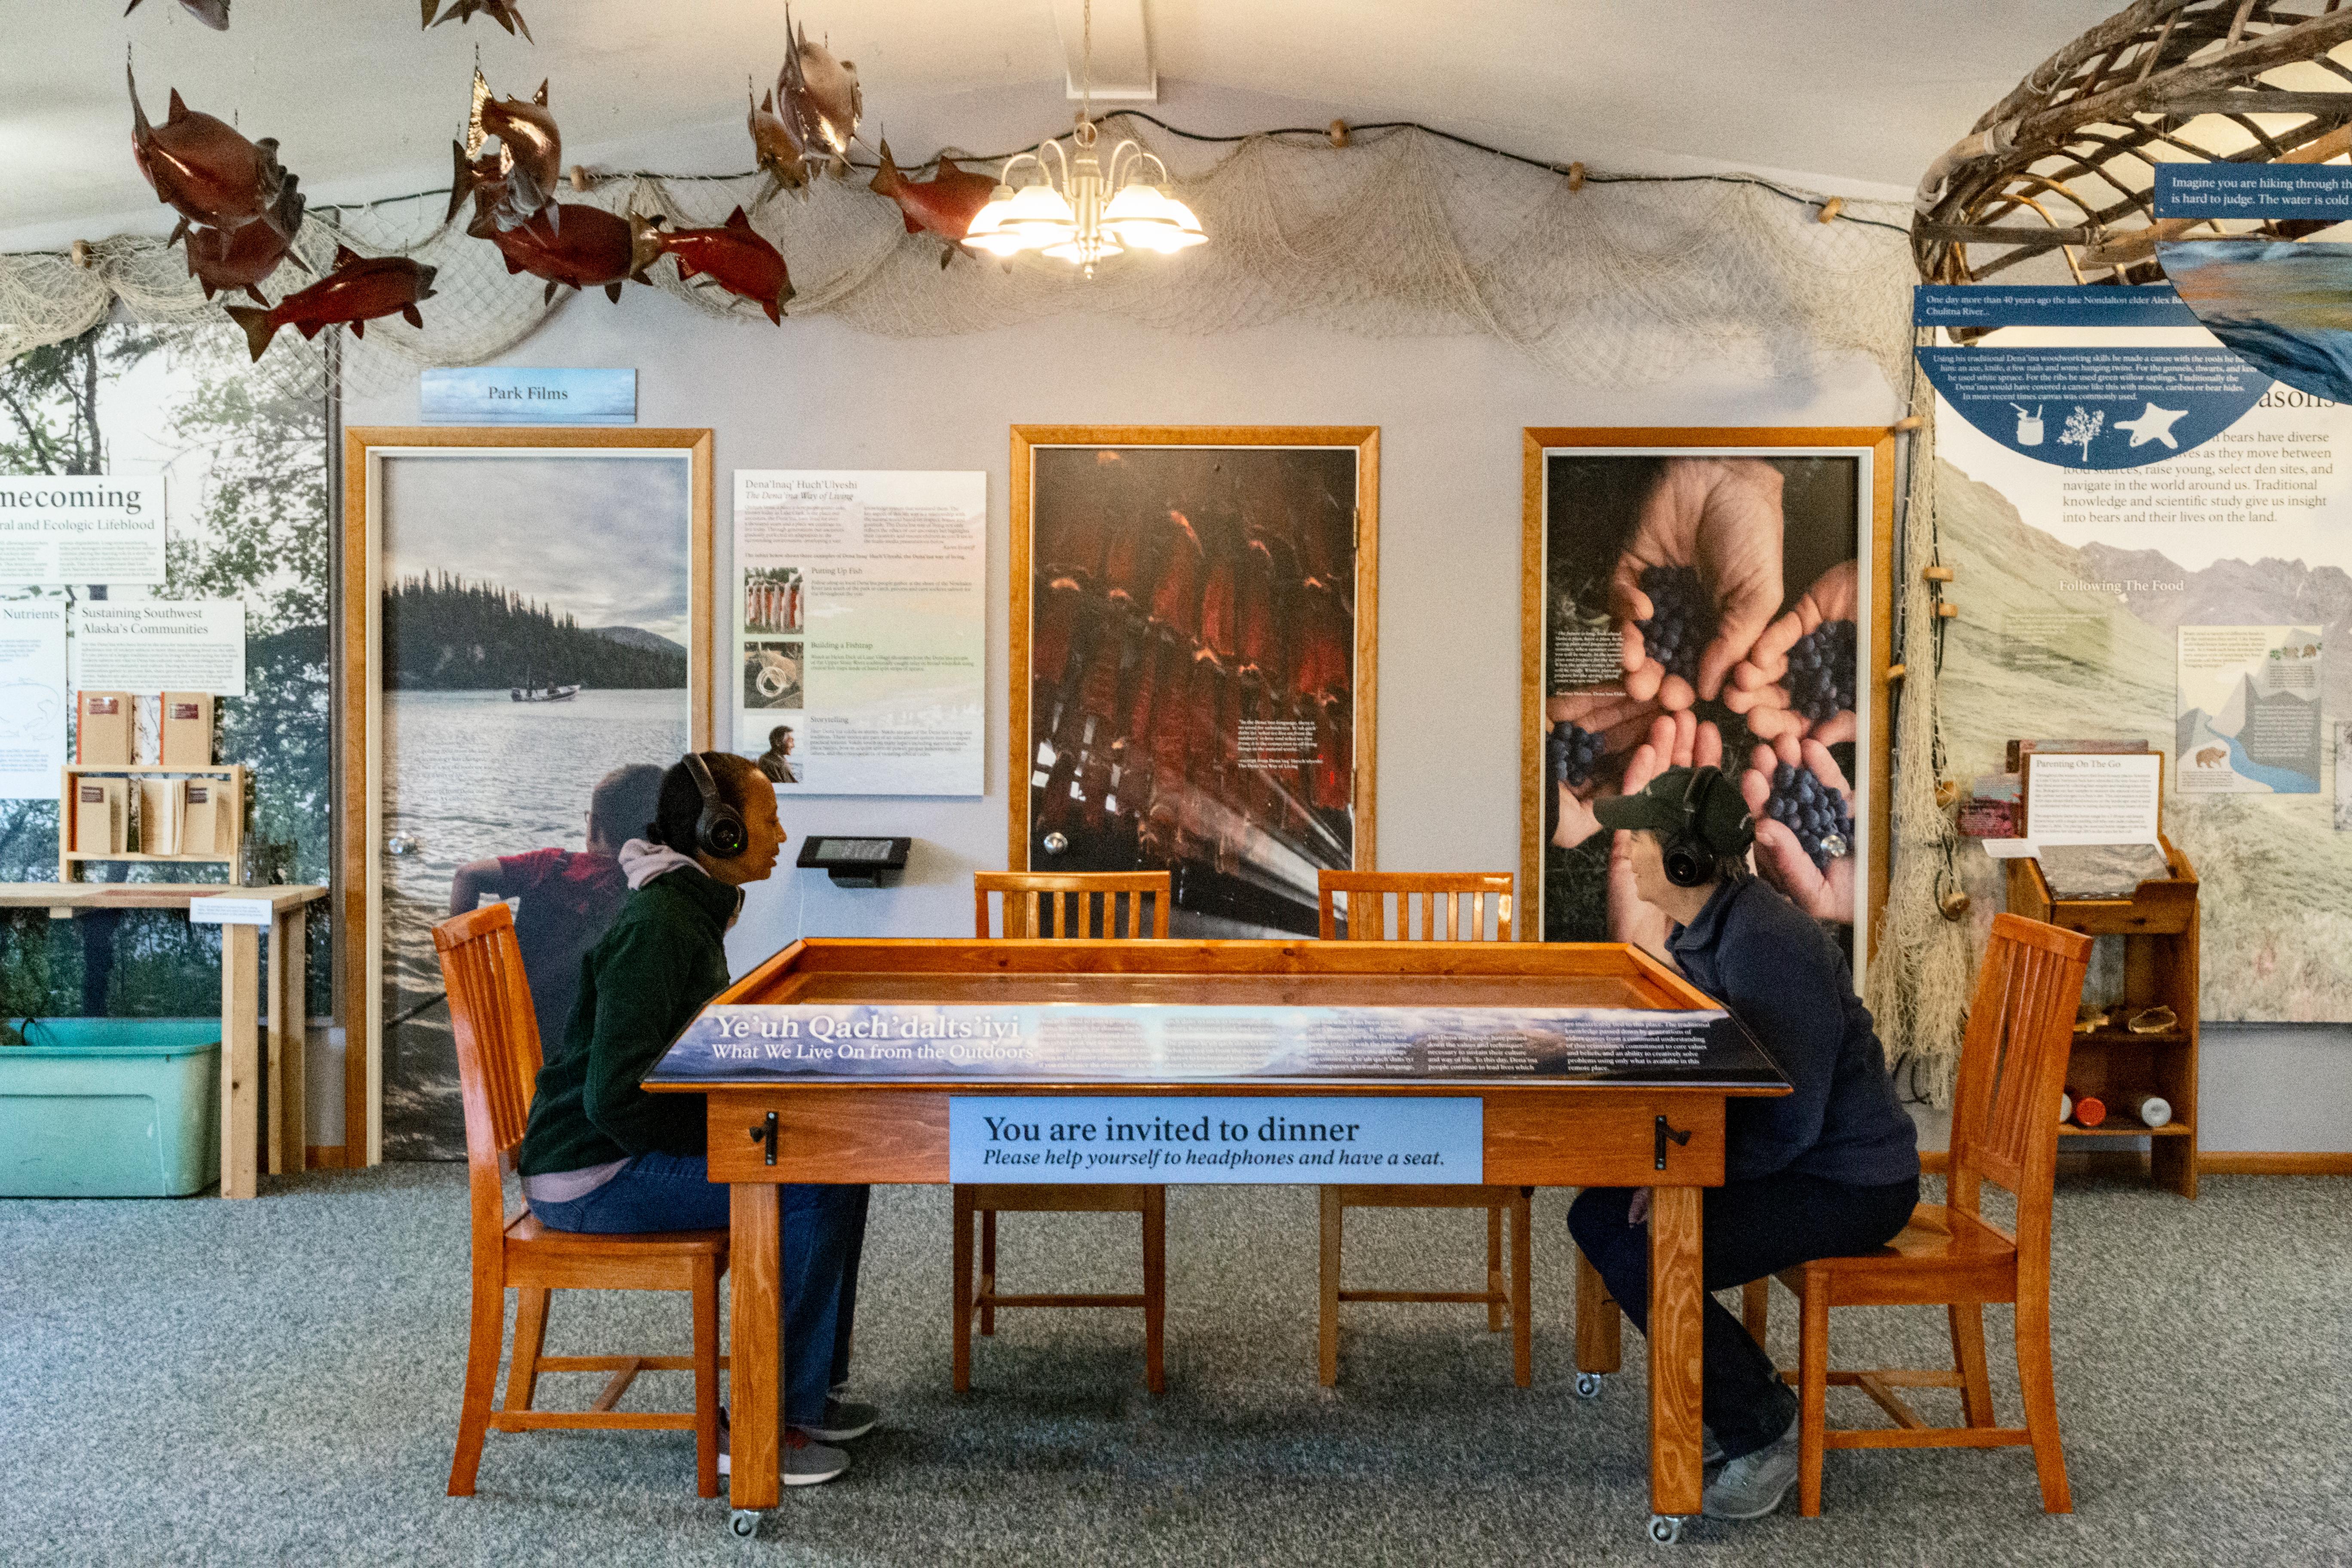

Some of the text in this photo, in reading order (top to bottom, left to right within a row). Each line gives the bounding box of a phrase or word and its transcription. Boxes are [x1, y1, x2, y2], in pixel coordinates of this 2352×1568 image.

[2173, 177, 2215, 190] Imagine
[2218, 181, 2238, 190] you
[2260, 178, 2294, 191] hiking
[2296, 178, 2339, 191] through
[2171, 194, 2180, 203] is
[2183, 193, 2208, 204] hard
[2223, 194, 2255, 206] judge.
[2258, 194, 2279, 204] The
[2282, 196, 2312, 205] water
[2315, 195, 2323, 204] is
[2325, 195, 2349, 205] cold
[1945, 296, 1958, 305] day
[489, 386, 568, 400] Park Films
[2223, 431, 2329, 442] bears have diverse
[2219, 447, 2242, 461] they
[2282, 447, 2331, 458] between
[2145, 464, 2172, 475] raise
[2175, 466, 2215, 477] young,
[2218, 463, 2251, 474] select
[2255, 464, 2272, 474] den
[2281, 465, 2309, 474] sites,
[2314, 465, 2332, 474] and
[2063, 480, 2111, 492] navigate
[2115, 480, 2125, 490] in
[2129, 480, 2147, 490] the
[2150, 480, 2185, 490] world
[2188, 480, 2231, 490] around
[2256, 479, 2317, 490] Traditional
[801, 492, 817, 501] Way
[819, 492, 828, 500] of
[829, 492, 854, 502] Living
[2063, 496, 2127, 508] knowledge
[2130, 496, 2152, 506] and
[2156, 495, 2208, 506] scientific
[2211, 495, 2242, 509] study
[2245, 497, 2268, 508] give
[2288, 495, 2326, 508] insight
[2063, 511, 2086, 522] into
[2089, 512, 2120, 522] bears
[2124, 511, 2145, 522] and
[2149, 511, 2177, 522] their
[2180, 511, 2205, 522] lives
[2227, 511, 2245, 522] the
[2249, 511, 2277, 522] land.
[17, 519, 40, 530] and
[43, 519, 93, 533] Ecologic
[98, 519, 155, 530] Lifeblood
[812, 567, 836, 576] Putting
[837, 567, 847, 576] Up
[2060, 579, 2184, 594] Following The Food
[3, 608, 60, 619] Nutrients
[82, 608, 202, 621] Sustaining Southwest
[83, 623, 208, 634] Alaska's Communities
[846, 642, 873, 650] Fishtrap
[811, 716, 849, 725] Storytelling
[2037, 760, 2074, 769] Parenting
[712, 1044, 1034, 1059] What We Live On from the Outdoors
[985, 1116, 1359, 1141] You are invited to dinner
[984, 1148, 1445, 1169] Please help yourself to headphones and have a seat.
